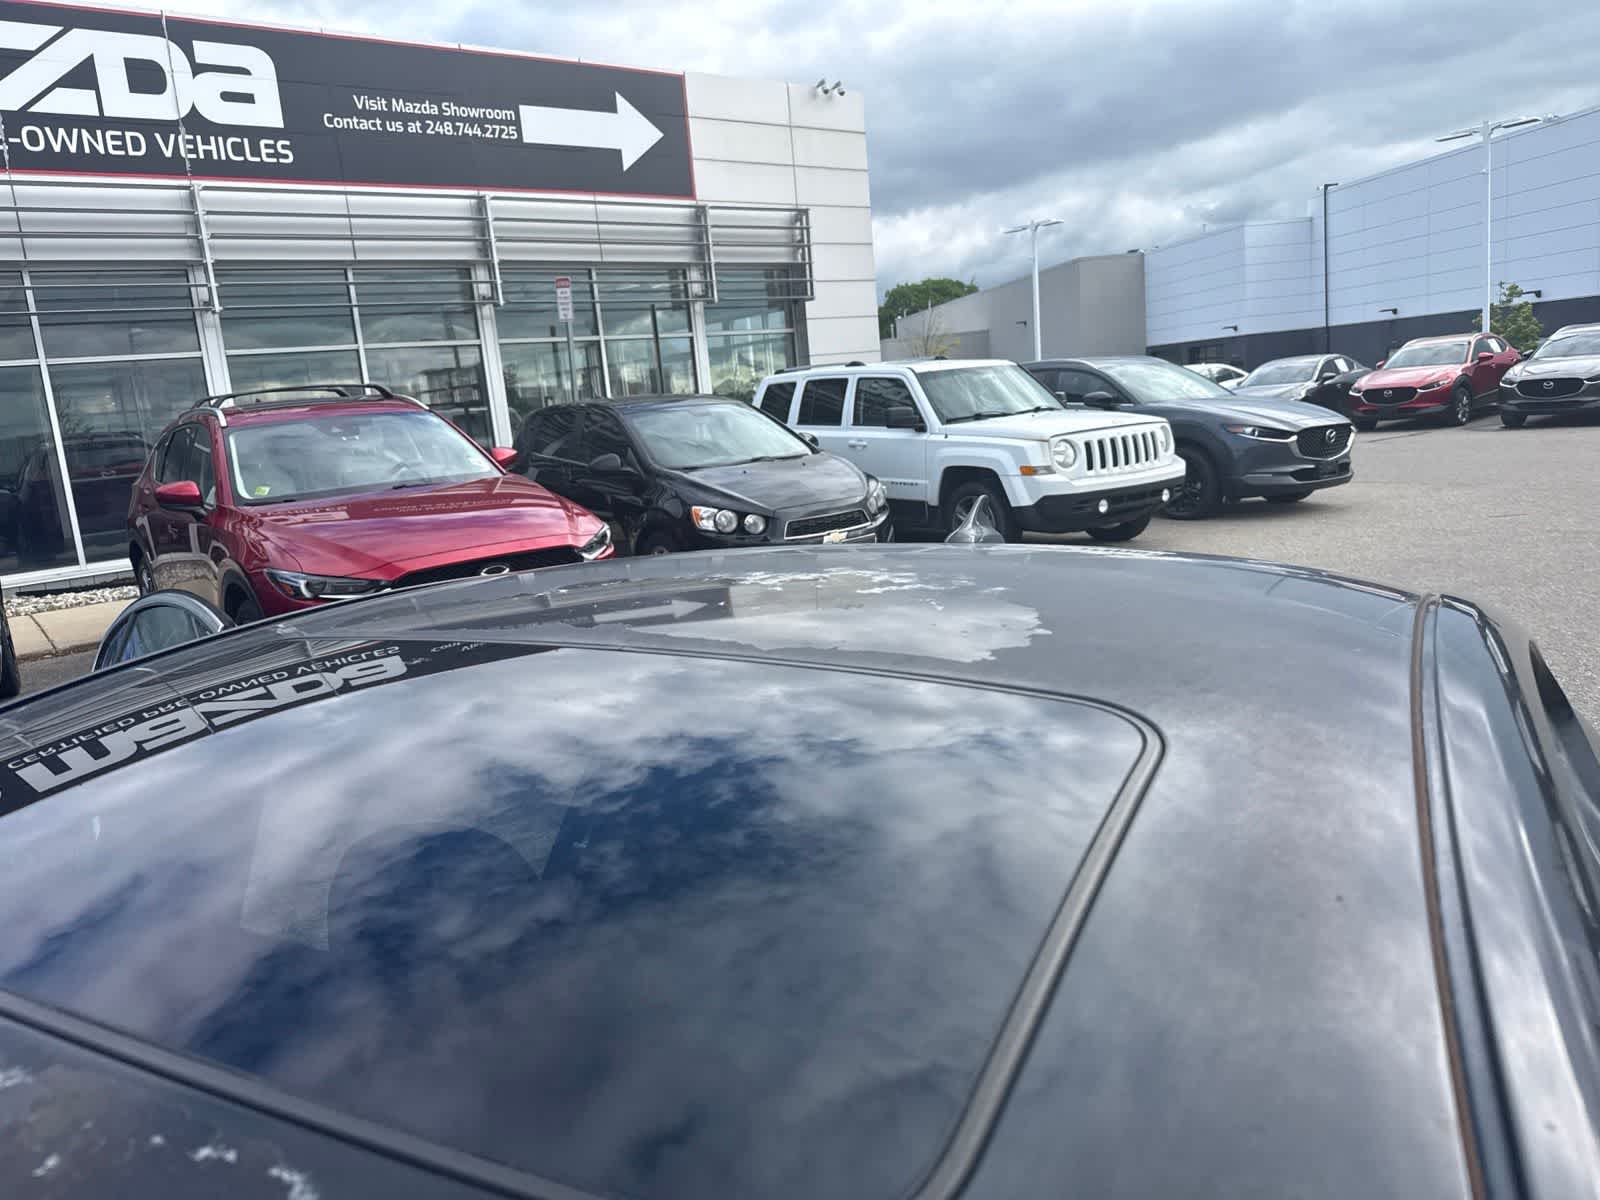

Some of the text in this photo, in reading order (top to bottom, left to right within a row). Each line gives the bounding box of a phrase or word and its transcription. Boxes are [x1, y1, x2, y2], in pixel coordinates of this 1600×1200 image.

[352, 94, 516, 121] Visit Mazda Showroom
[323, 113, 518, 140] Contact us at 248.744.2725
[0, 125, 294, 164] -OWNED VEHICLES
